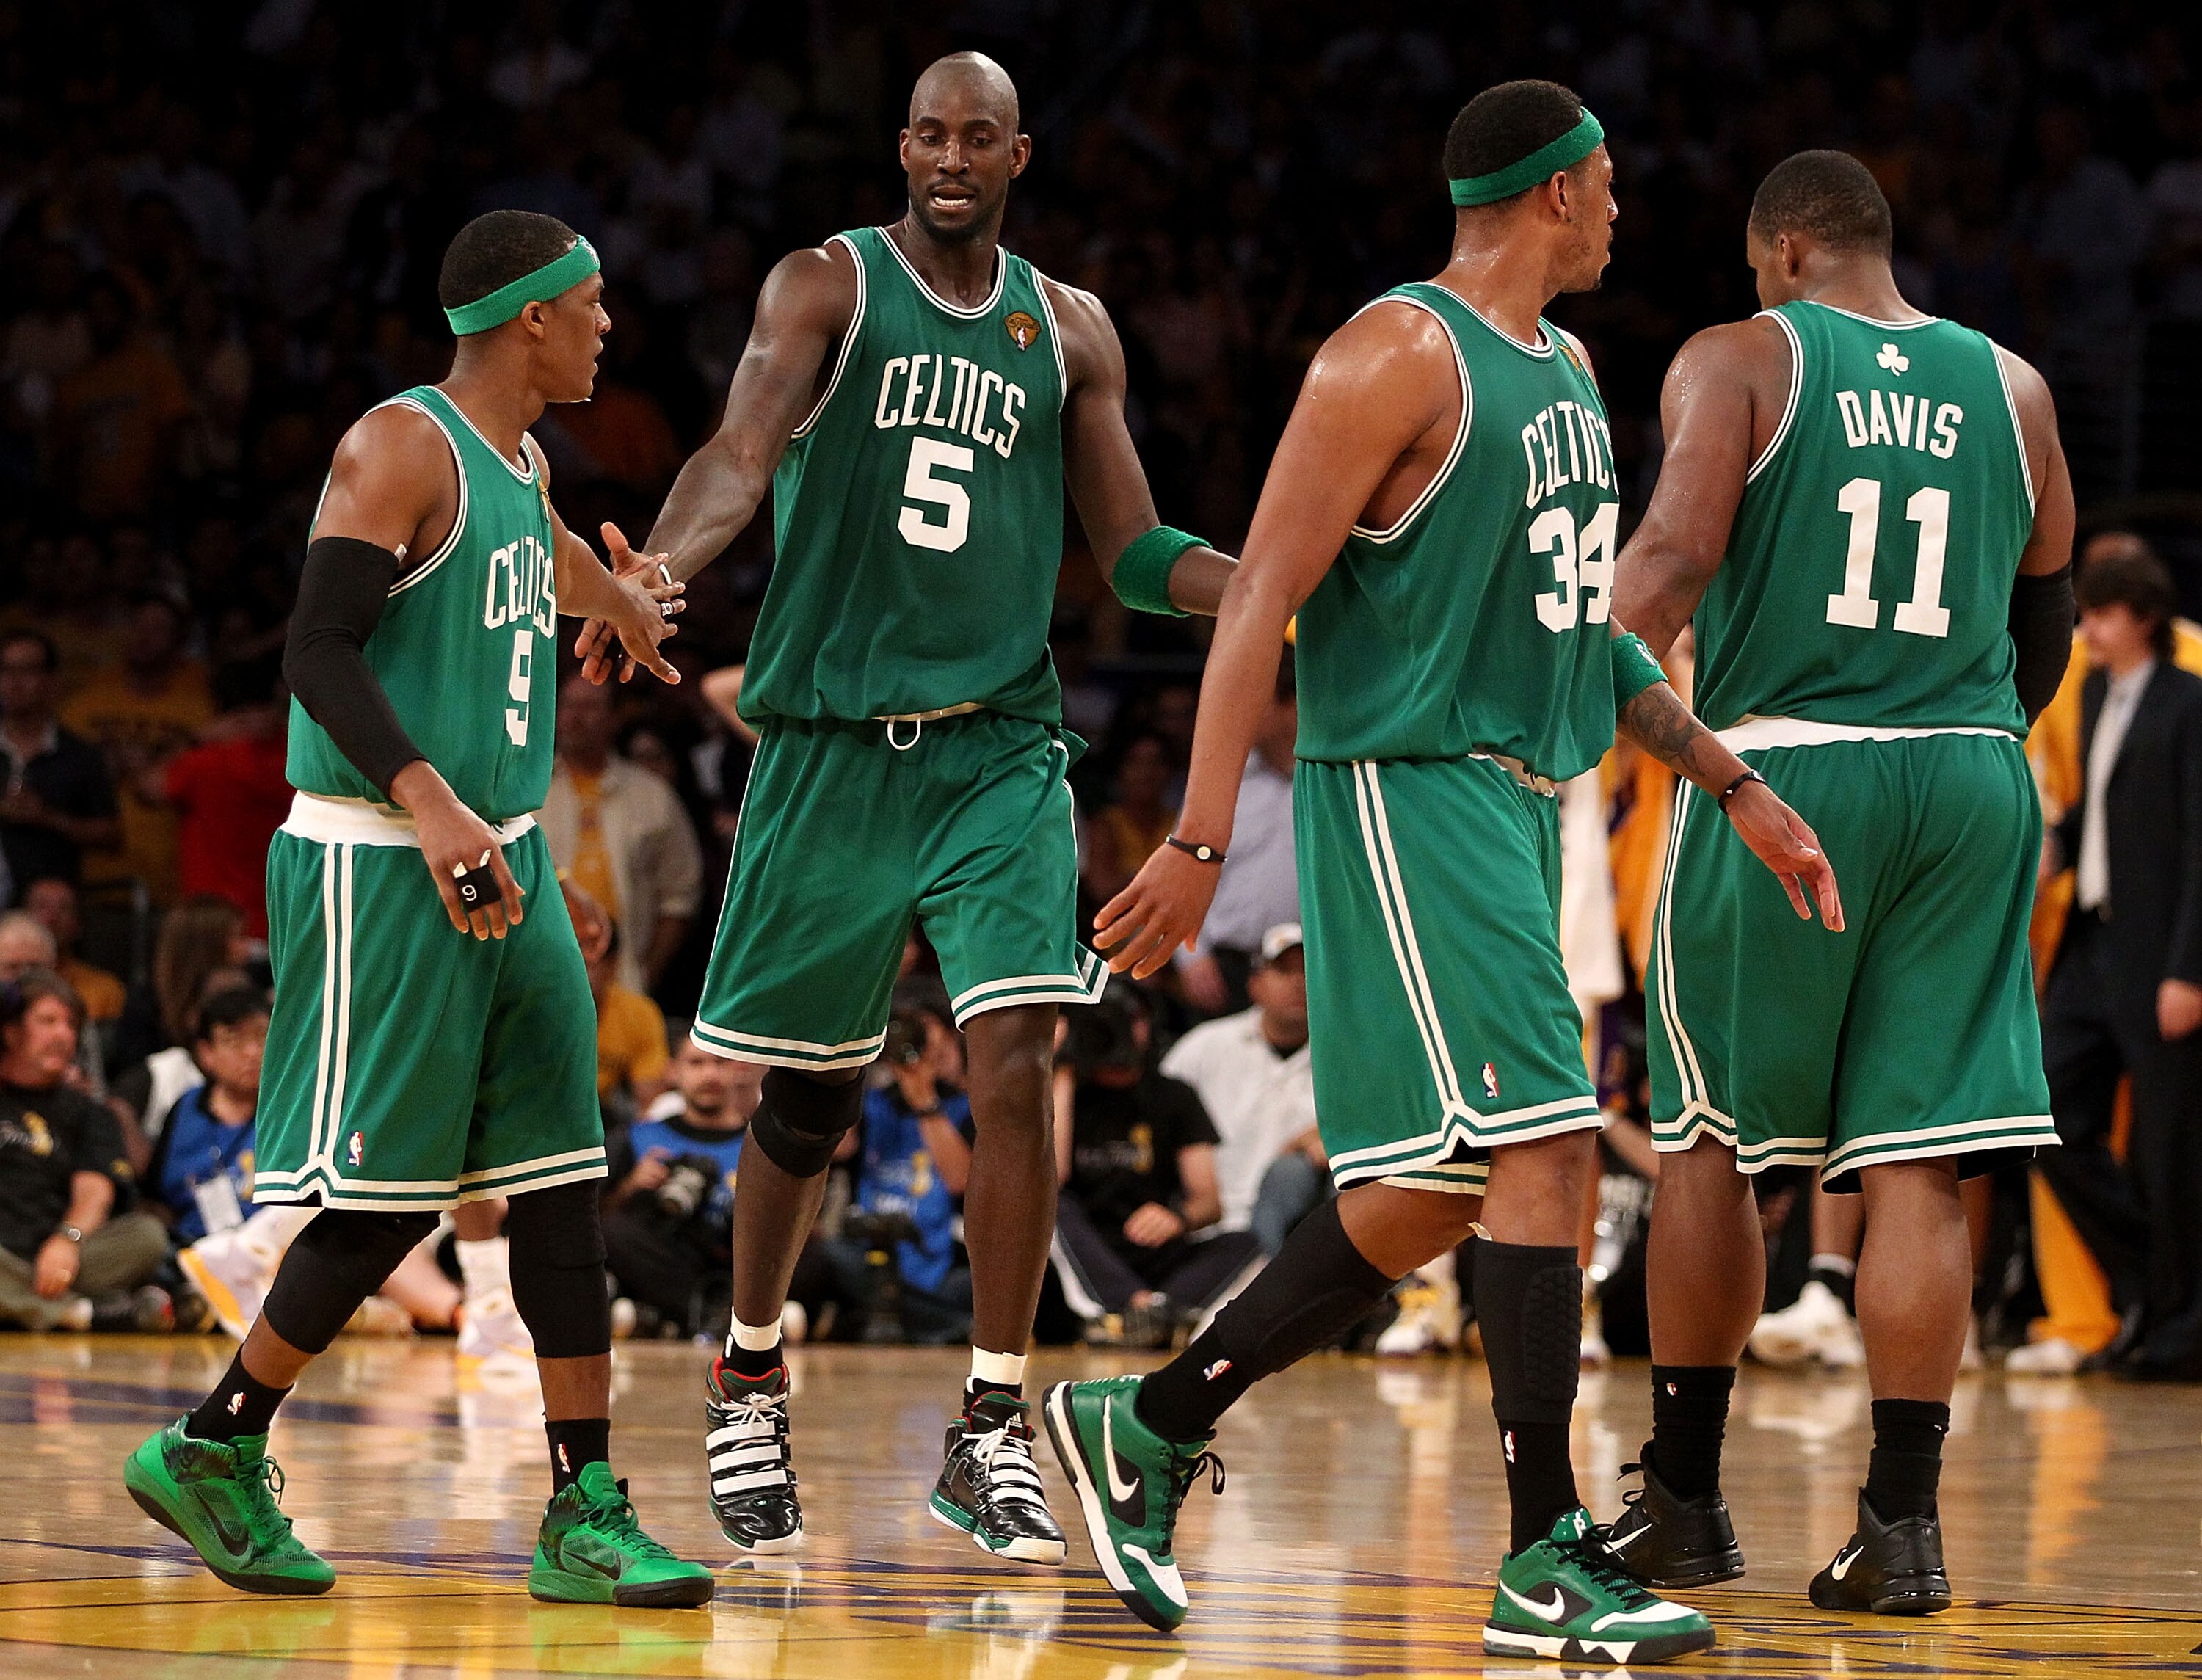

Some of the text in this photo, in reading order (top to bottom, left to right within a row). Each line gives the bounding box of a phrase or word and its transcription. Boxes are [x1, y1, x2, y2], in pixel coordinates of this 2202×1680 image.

[874, 354, 1026, 459] CELTICS
[1836, 390, 1963, 459] DAVIS
[897, 435, 975, 553] 5
[484, 536, 557, 639] CELTICS
[1525, 503, 1620, 633] 34
[1825, 477, 1950, 638] 11
[505, 629, 534, 747] 9
[462, 884, 477, 901] 9
